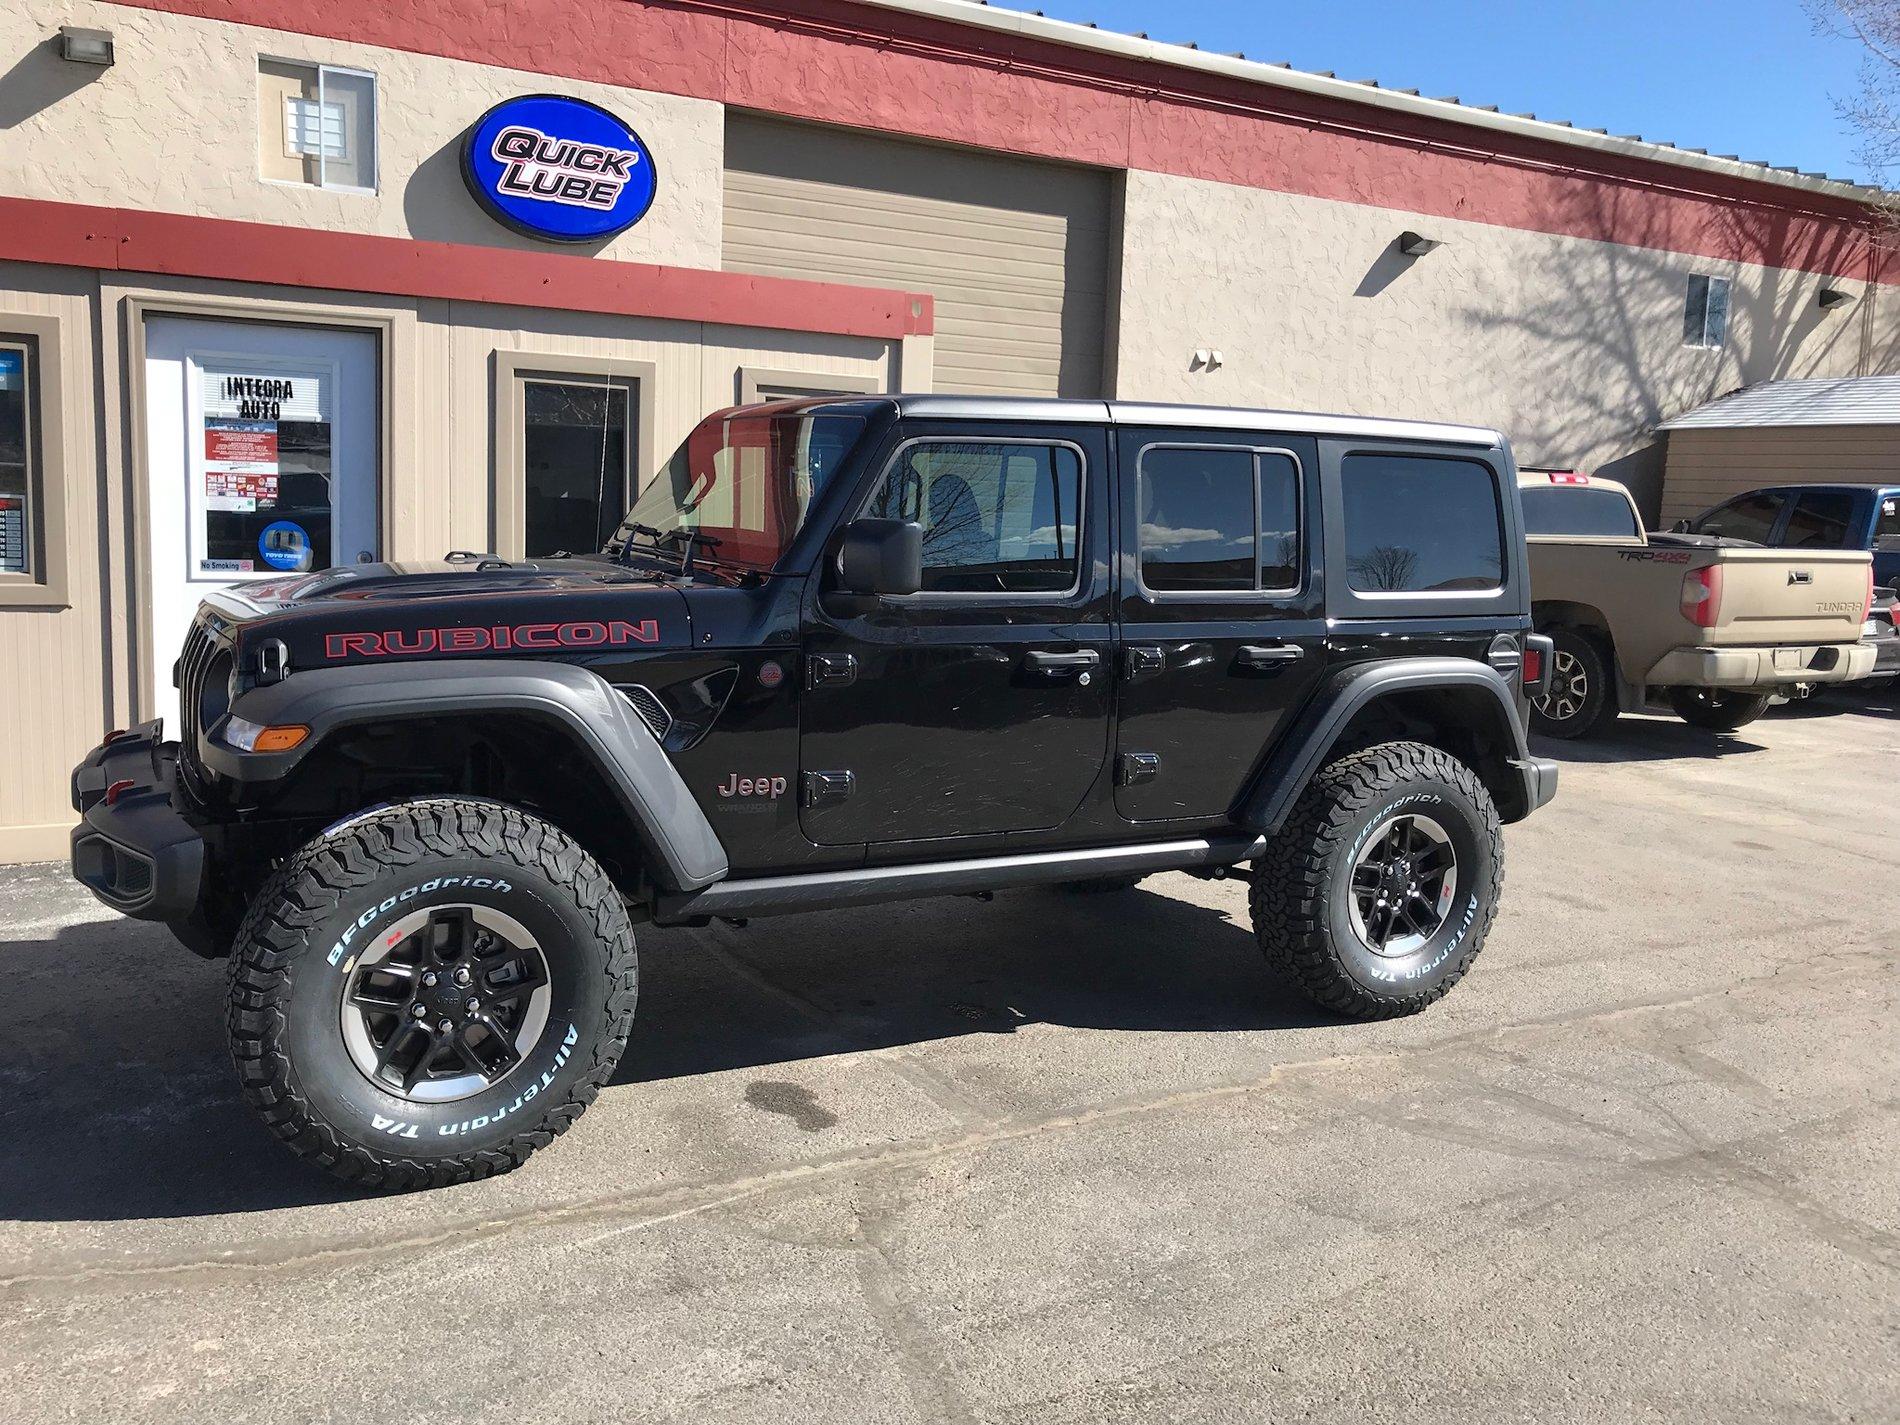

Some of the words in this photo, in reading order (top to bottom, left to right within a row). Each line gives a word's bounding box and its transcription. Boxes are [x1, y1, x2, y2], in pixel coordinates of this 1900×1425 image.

[497, 131, 633, 177] QUICK
[503, 163, 618, 205] LUBE
[226, 376, 294, 399] INTEGRA
[240, 400, 281, 420] AUTO
[201, 561, 211, 569] No
[211, 561, 240, 571] Smoking
[1617, 550, 1655, 562] TRD
[1816, 602, 1863, 612] TUNDRA
[325, 619, 660, 658] RUBICON
[718, 773, 787, 799] Jeep
[326, 875, 513, 967] BFGoodrich
[1404, 893, 1478, 980] All-Terrain
[1370, 967, 1397, 982] T/A
[438, 1023, 579, 1137] All-Terrain
[370, 1113, 419, 1139] T/A
